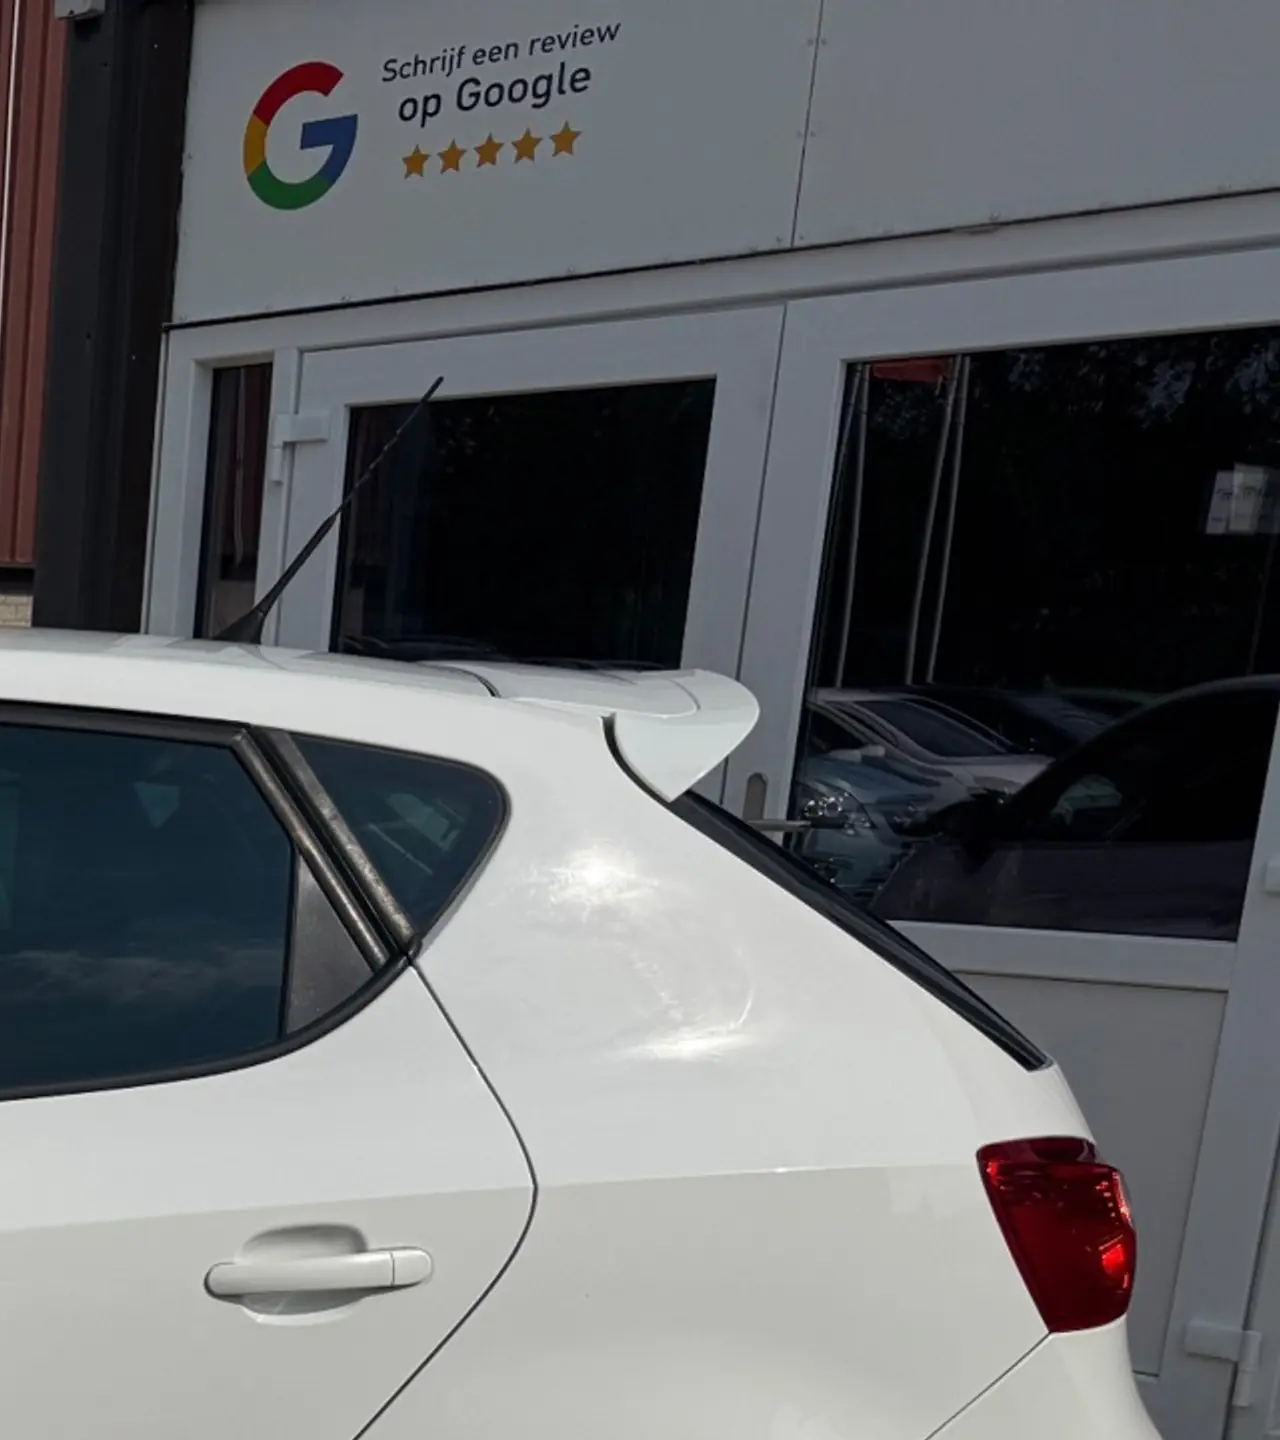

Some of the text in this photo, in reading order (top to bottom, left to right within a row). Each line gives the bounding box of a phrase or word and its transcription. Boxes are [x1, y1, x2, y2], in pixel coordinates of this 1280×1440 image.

[381, 21, 622, 83] Schrijf een review
[398, 60, 592, 128] op Google
